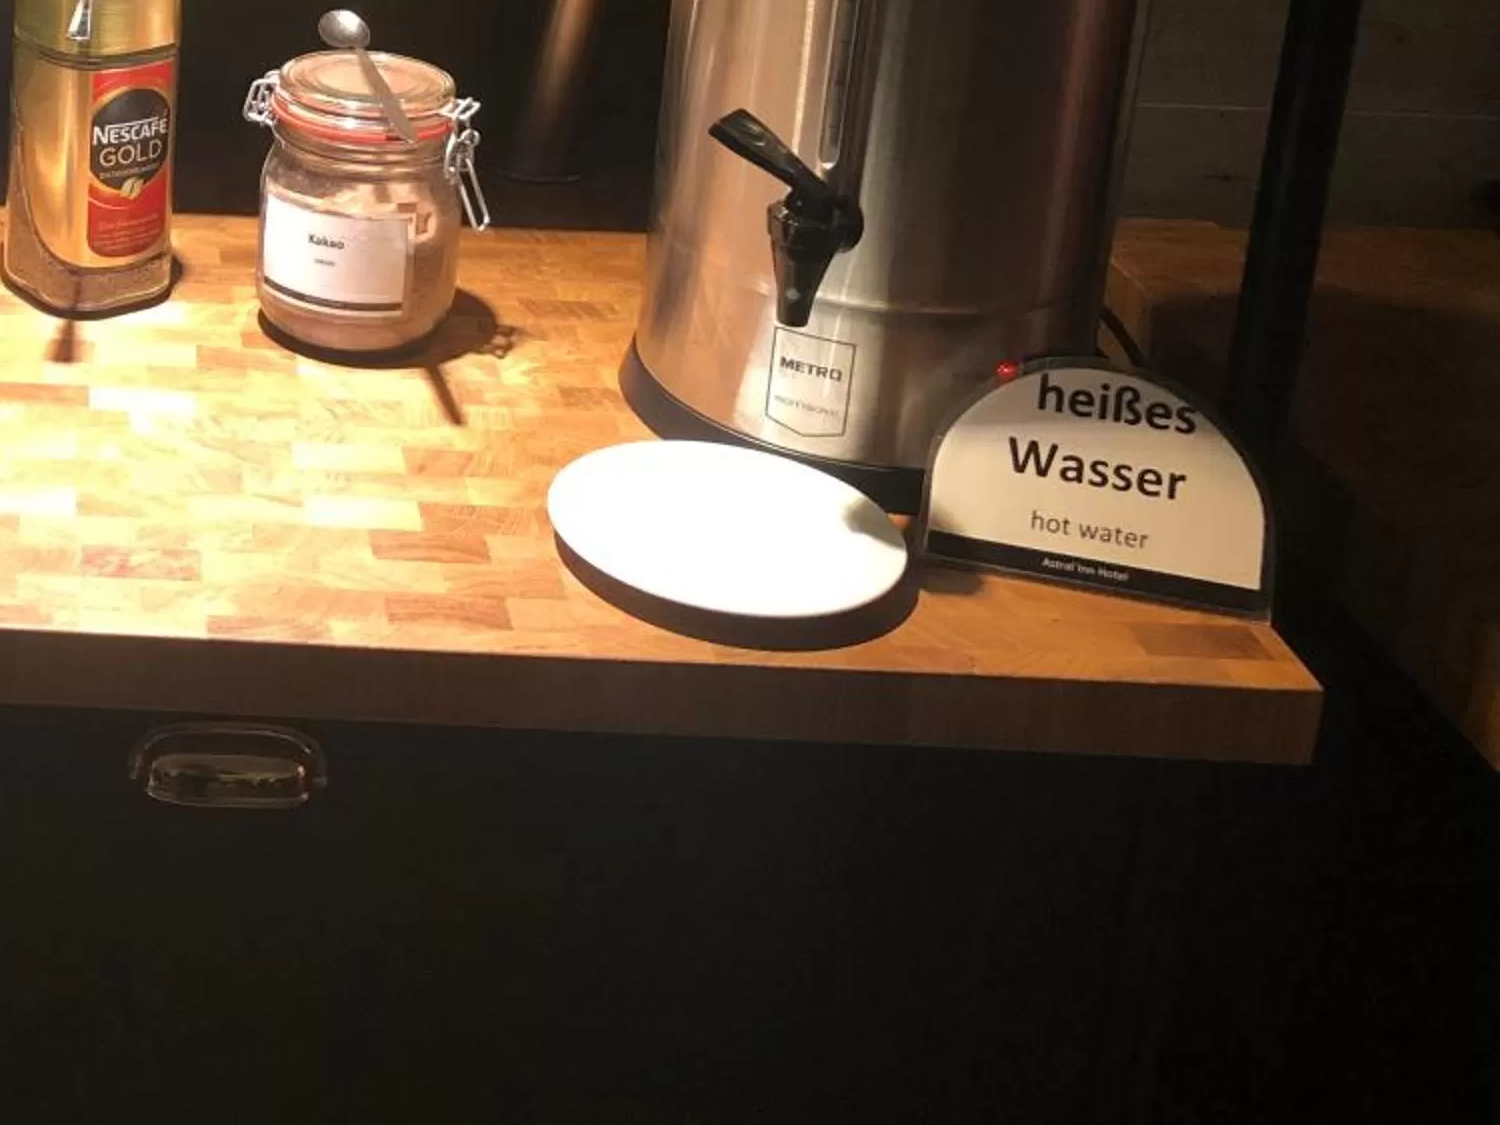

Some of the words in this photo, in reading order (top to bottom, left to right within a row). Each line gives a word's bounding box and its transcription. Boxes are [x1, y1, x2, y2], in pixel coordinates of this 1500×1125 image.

[99, 138, 162, 167] GOLD
[307, 234, 345, 250] Kakao
[780, 356, 843, 382] METRO
[1037, 373, 1197, 435] heißes
[1008, 436, 1187, 500] Wasser
[1030, 509, 1070, 536] hot
[1079, 522, 1149, 549] water
